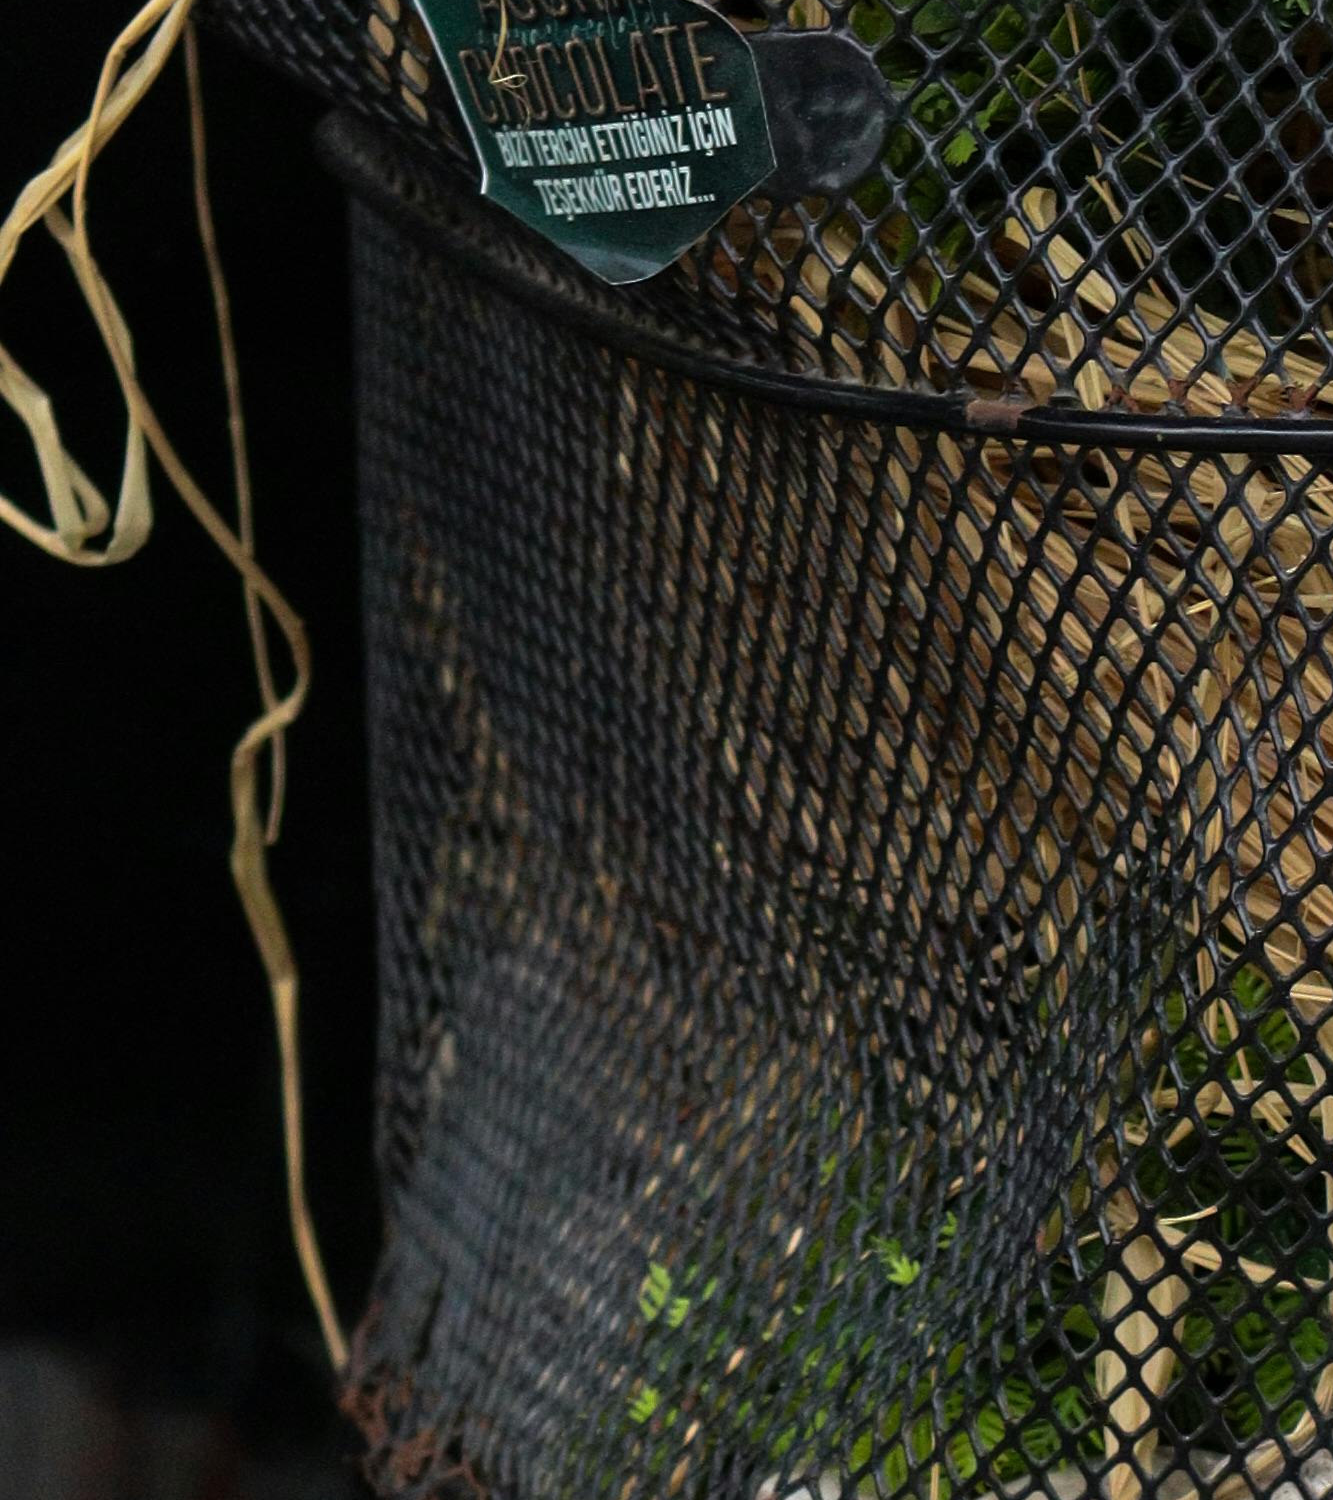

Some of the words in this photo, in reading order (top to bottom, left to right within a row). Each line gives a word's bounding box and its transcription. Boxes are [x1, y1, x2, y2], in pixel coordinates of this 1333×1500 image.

[458, 21, 730, 123] CHOCOLATE
[495, 124, 533, 167] BİZİ
[528, 122, 596, 167] TERCİH
[591, 110, 691, 162] ETTİĞİNİZ
[686, 103, 738, 156] İÇİN
[533, 168, 628, 221] TEŞEKKÜR
